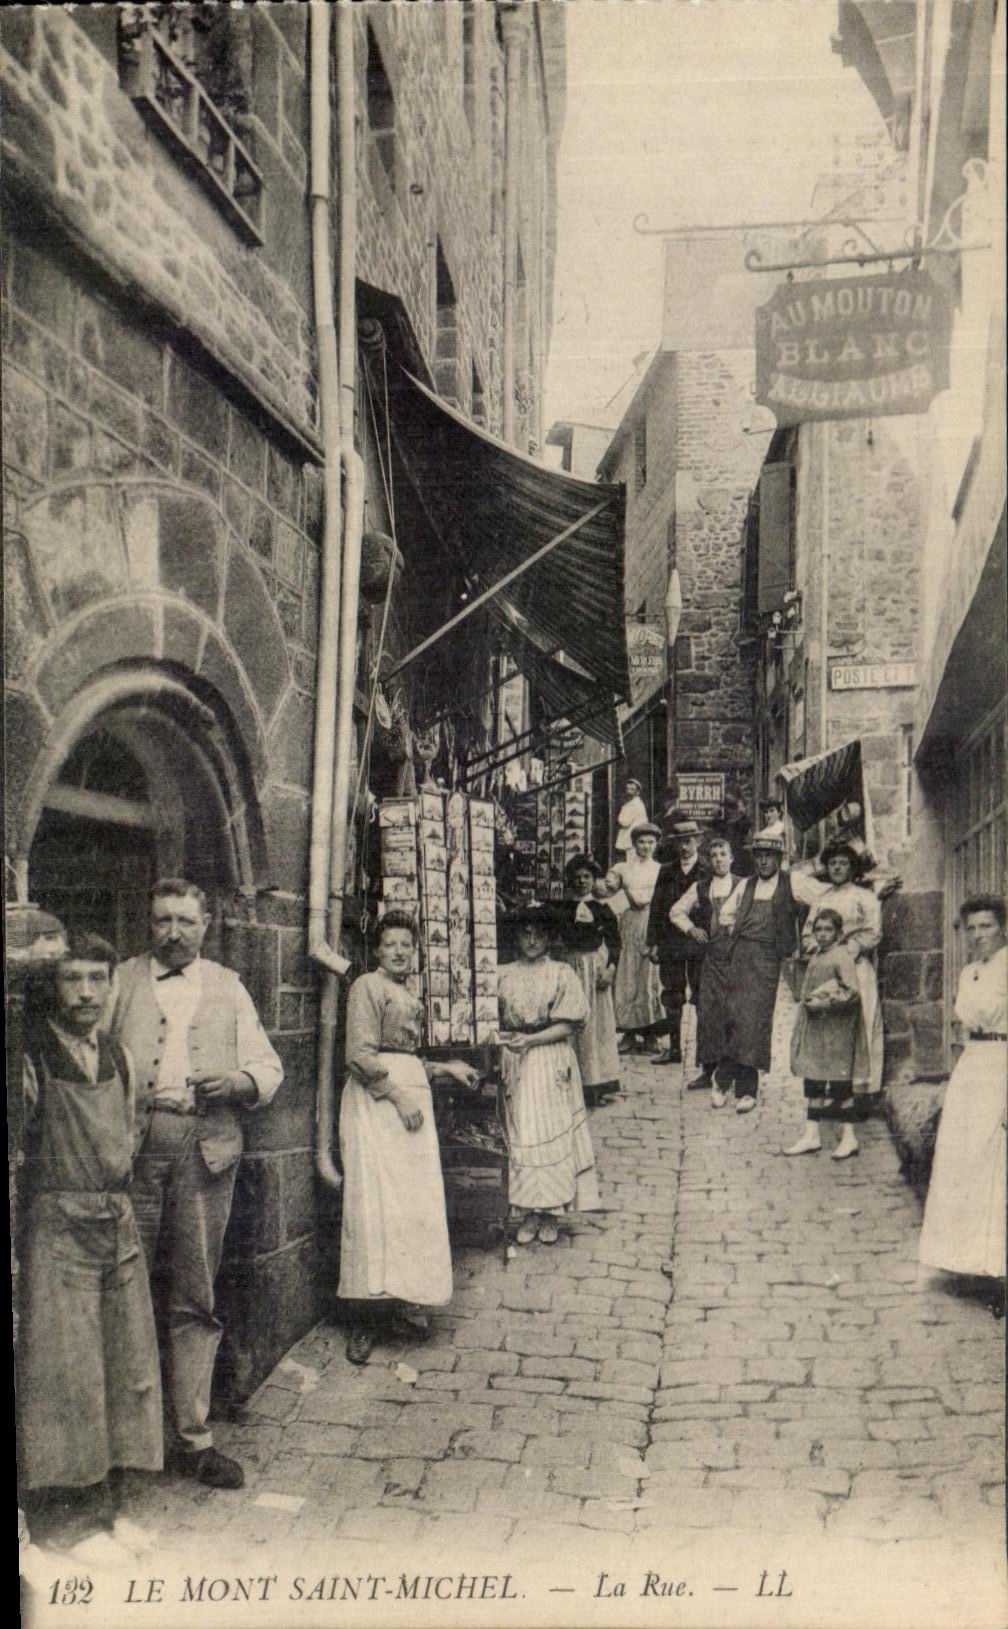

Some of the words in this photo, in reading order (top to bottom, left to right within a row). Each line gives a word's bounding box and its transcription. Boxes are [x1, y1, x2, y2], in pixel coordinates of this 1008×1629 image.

[770, 301, 806, 338] AU
[811, 286, 933, 321] MOUTON
[776, 330, 931, 370] BLANC
[833, 666, 878, 686] POSTE
[679, 785, 721, 801] BYRRH
